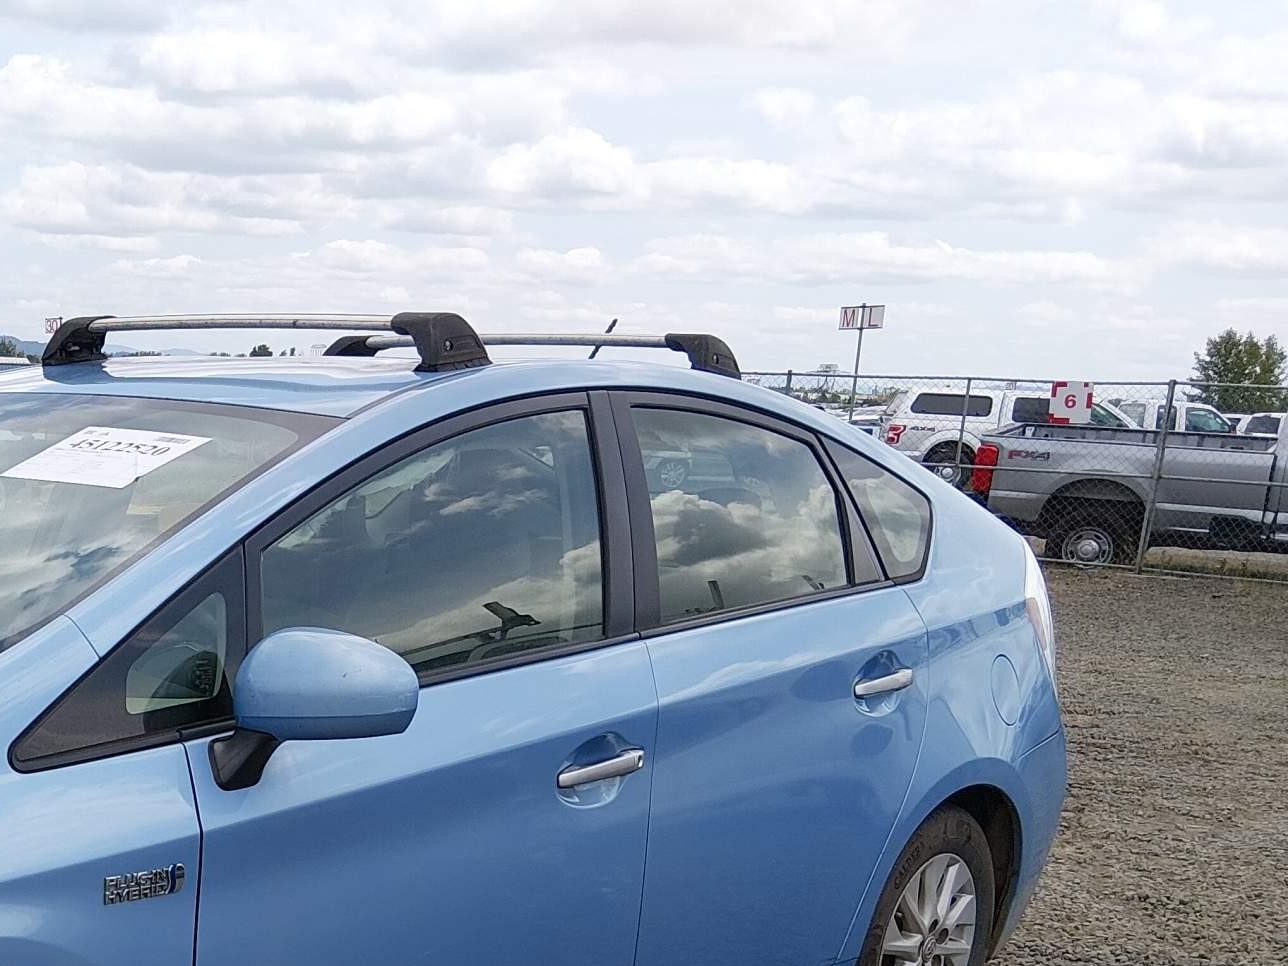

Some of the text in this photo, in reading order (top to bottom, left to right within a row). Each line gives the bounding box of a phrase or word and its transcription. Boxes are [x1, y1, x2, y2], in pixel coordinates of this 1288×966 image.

[842, 309, 856, 327] M
[868, 307, 879, 327] L
[1064, 394, 1077, 409] 6
[69, 438, 171, 456] 45122520
[105, 881, 169, 905] HYBRID
